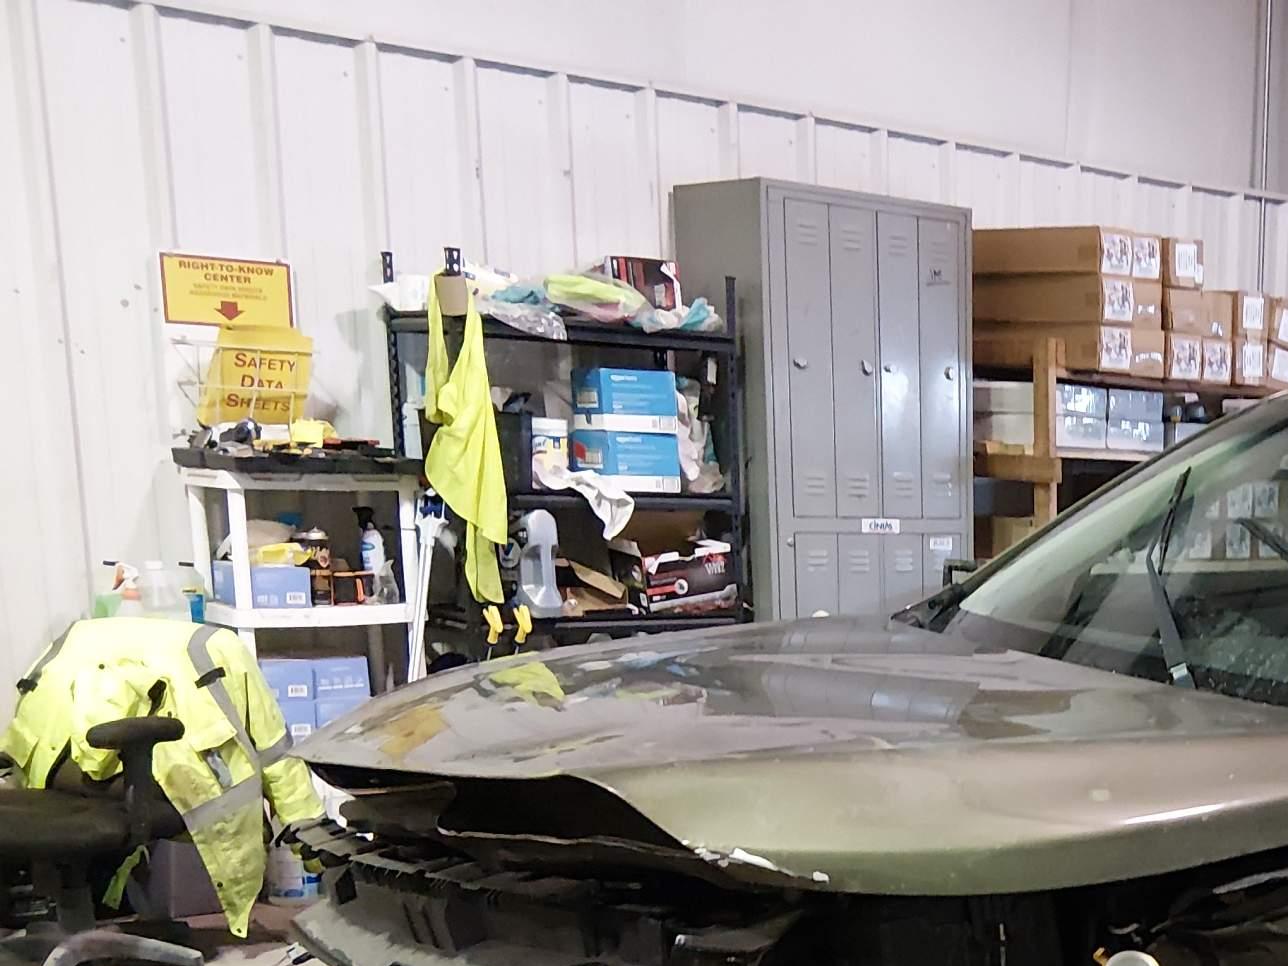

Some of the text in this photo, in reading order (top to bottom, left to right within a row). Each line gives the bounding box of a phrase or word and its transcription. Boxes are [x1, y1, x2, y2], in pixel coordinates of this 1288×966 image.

[204, 272, 252, 284] CENTER
[234, 352, 296, 372] SAFETY
[241, 374, 284, 390] DATA
